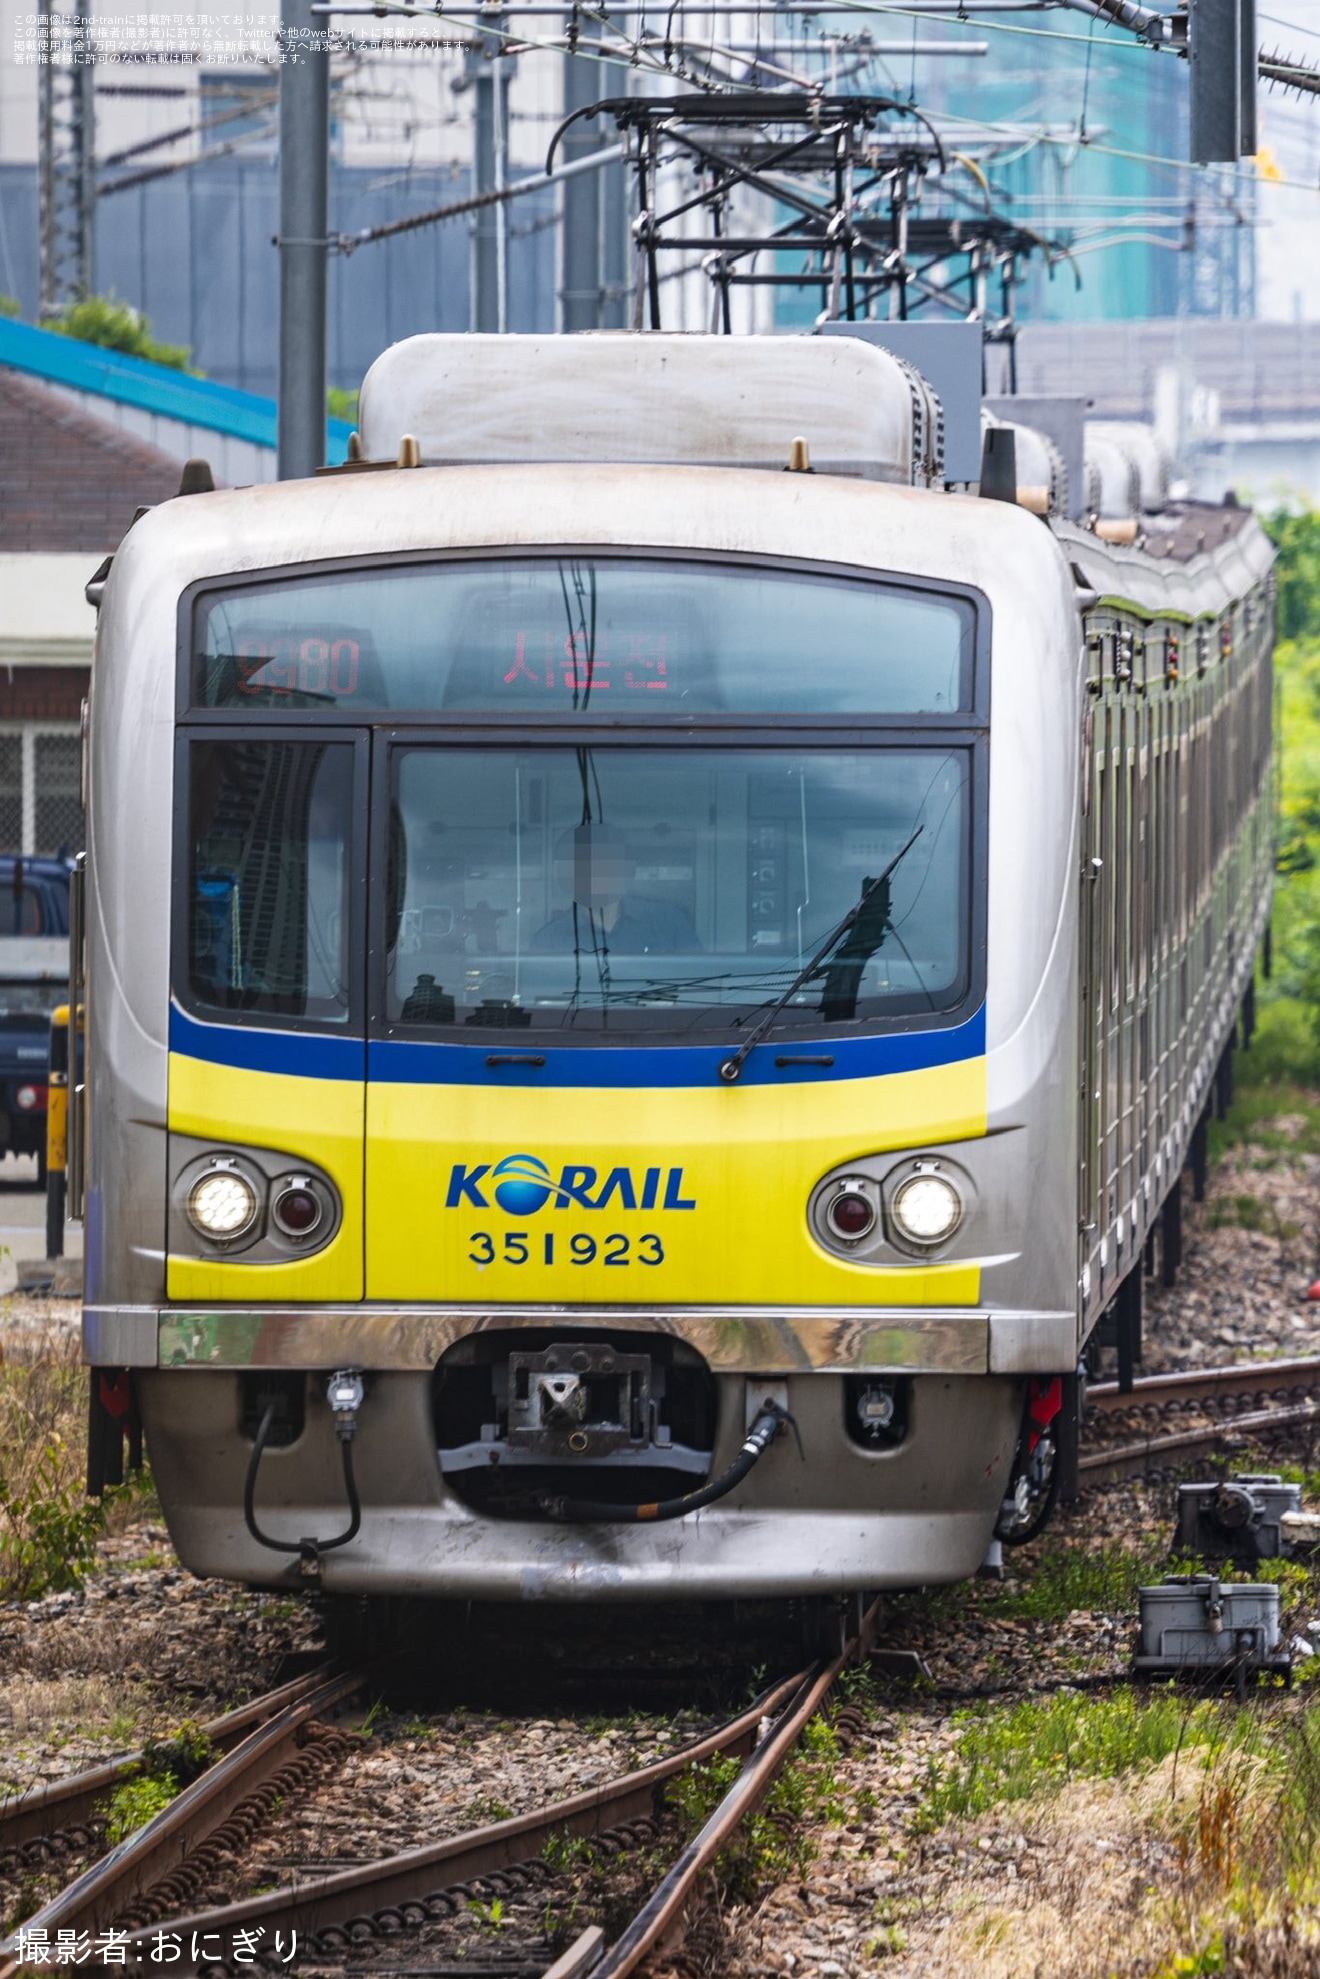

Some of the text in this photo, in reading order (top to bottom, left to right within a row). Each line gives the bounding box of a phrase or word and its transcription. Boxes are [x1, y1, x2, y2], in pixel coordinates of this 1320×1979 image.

[504, 631, 667, 688] 시운전
[445, 1154, 696, 1216] KORAIL
[468, 1232, 664, 1266] 351923
